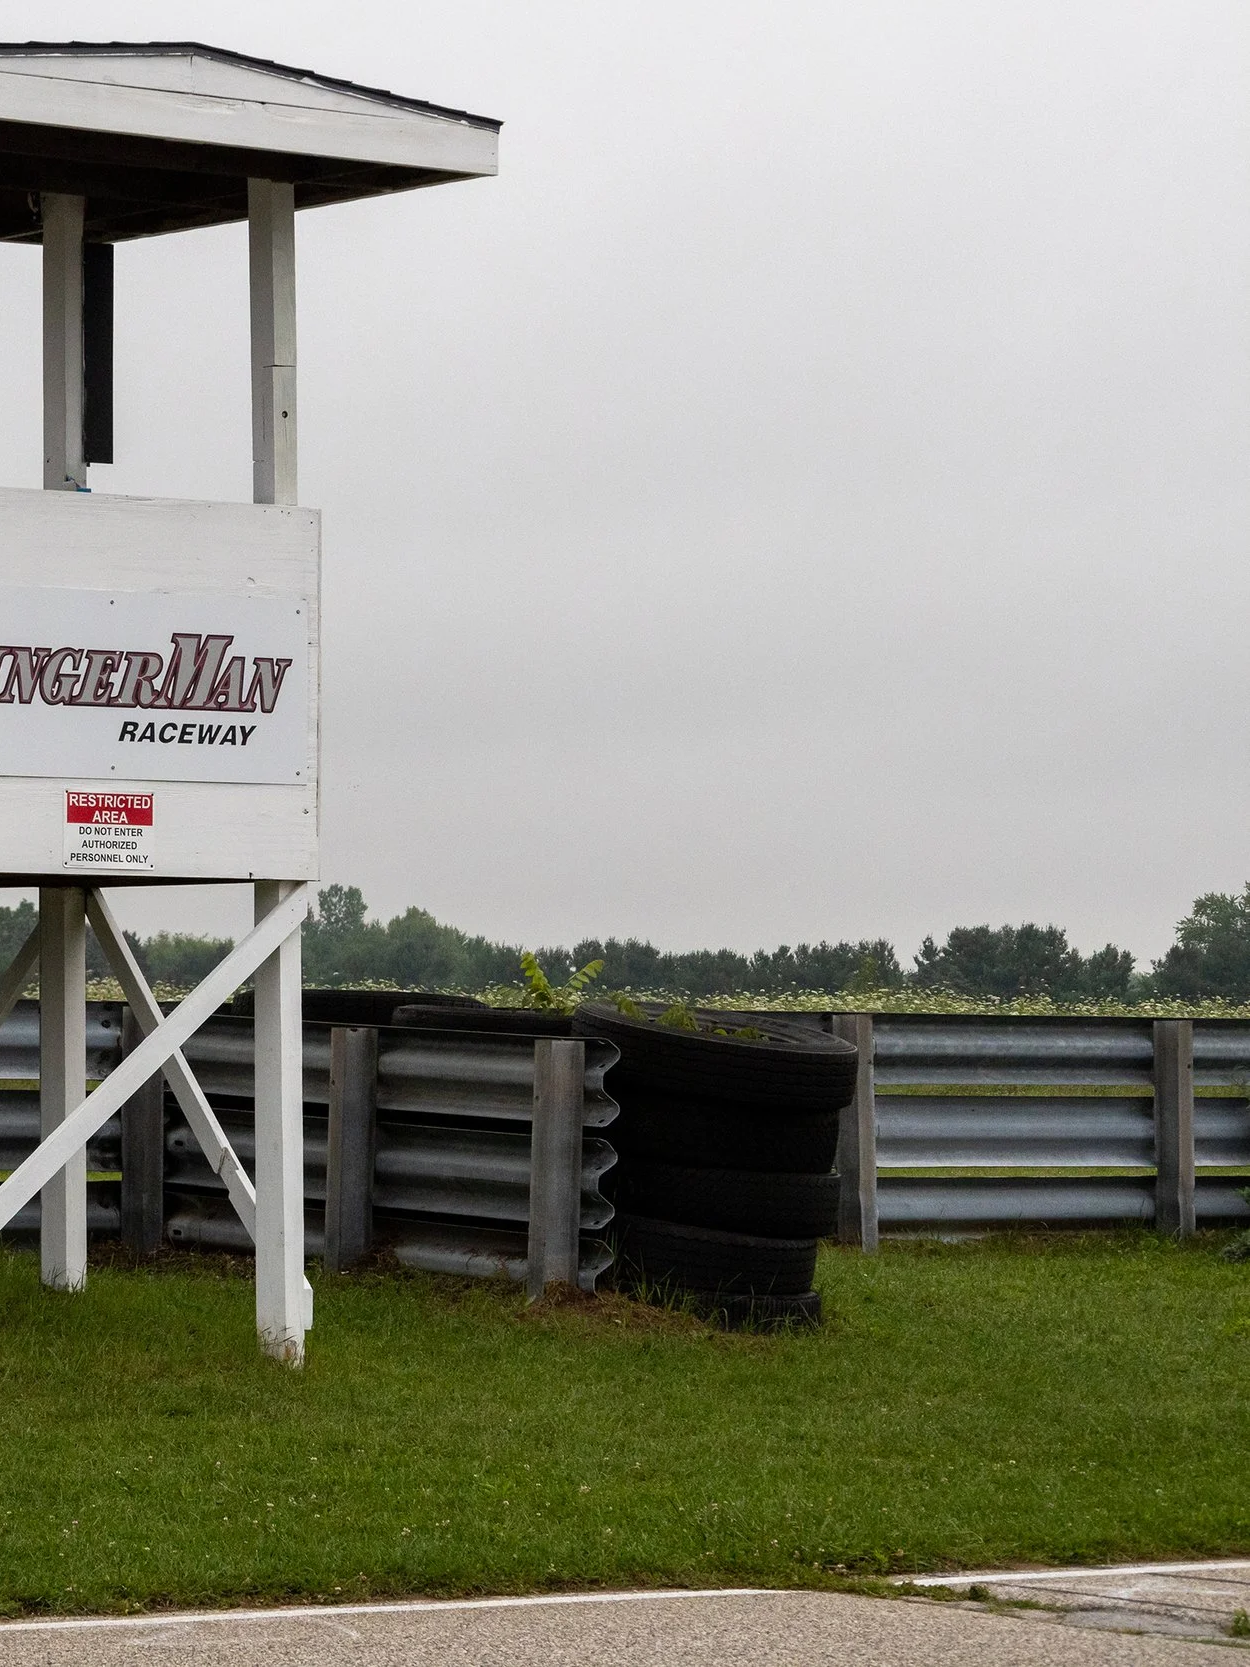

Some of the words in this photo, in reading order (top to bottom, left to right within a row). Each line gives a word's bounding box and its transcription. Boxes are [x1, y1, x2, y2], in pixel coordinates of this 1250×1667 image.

[118, 721, 257, 746] RACEWAY
[69, 794, 151, 809] RESTRICTED
[92, 810, 128, 824] AREA
[79, 826, 92, 835] DO
[94, 827, 112, 836] NOT
[114, 828, 143, 837] ENTER
[81, 840, 138, 850] AUTHORIZED
[70, 852, 124, 863] PERSONNEL
[125, 854, 149, 864] ONLY
